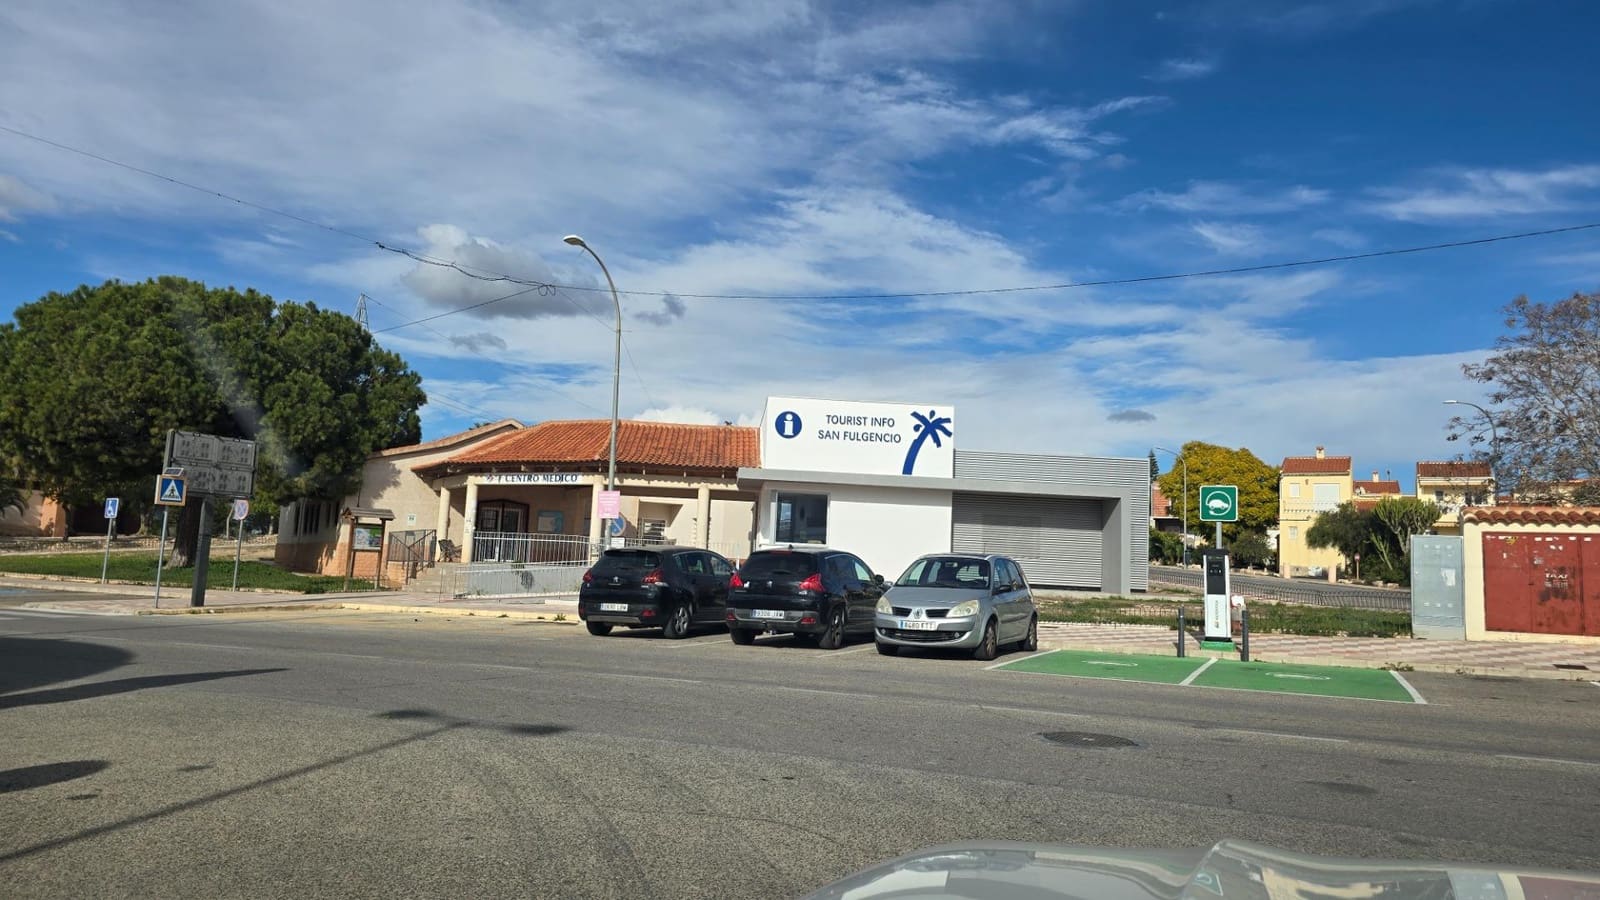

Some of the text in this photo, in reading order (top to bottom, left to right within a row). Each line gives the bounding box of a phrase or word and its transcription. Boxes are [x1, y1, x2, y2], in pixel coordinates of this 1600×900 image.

[826, 415, 896, 428] TOURIST INFO
[818, 429, 902, 444] SAN FULGENCIO
[505, 474, 540, 483] CENTRO
